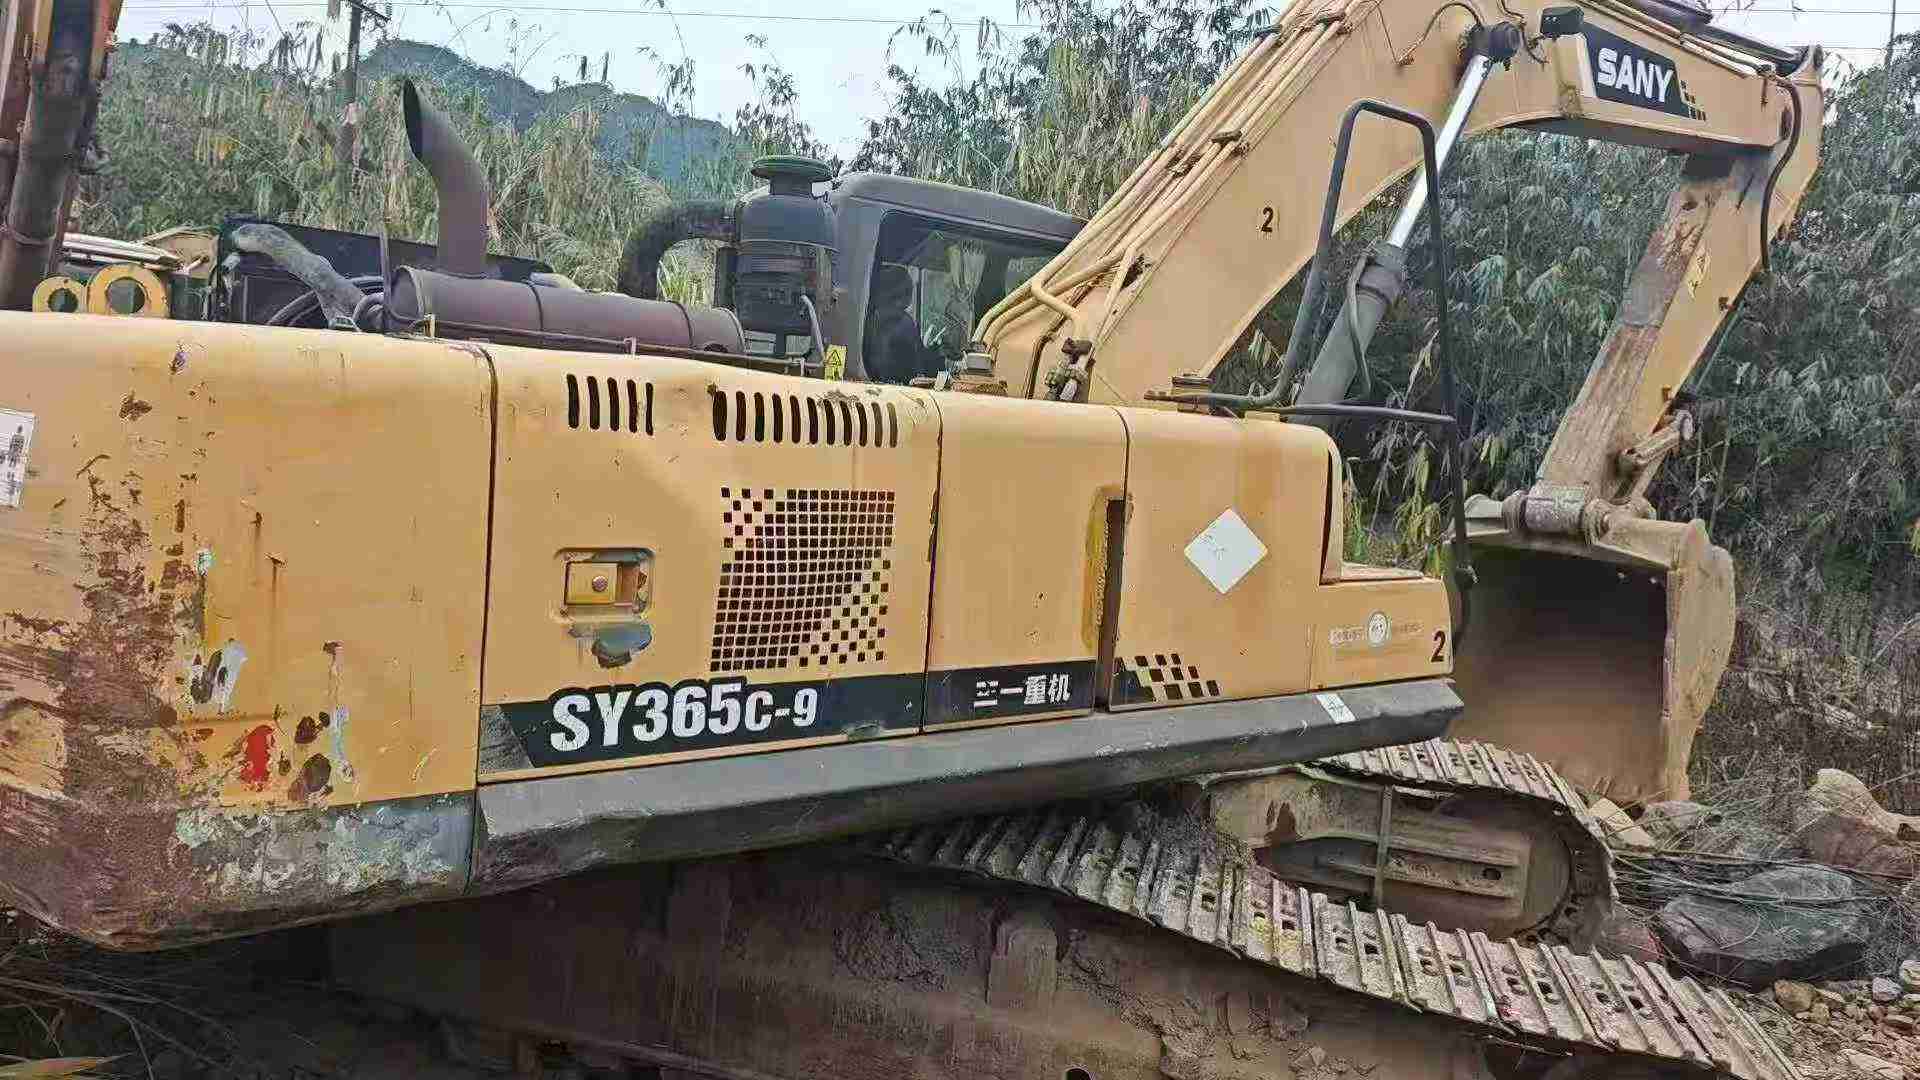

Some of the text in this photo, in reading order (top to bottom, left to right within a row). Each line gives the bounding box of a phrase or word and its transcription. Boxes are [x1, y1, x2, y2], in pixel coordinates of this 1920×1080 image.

[1597, 47, 1674, 103] SANY
[1261, 207, 1274, 232] 2
[1430, 630, 1446, 662] 2
